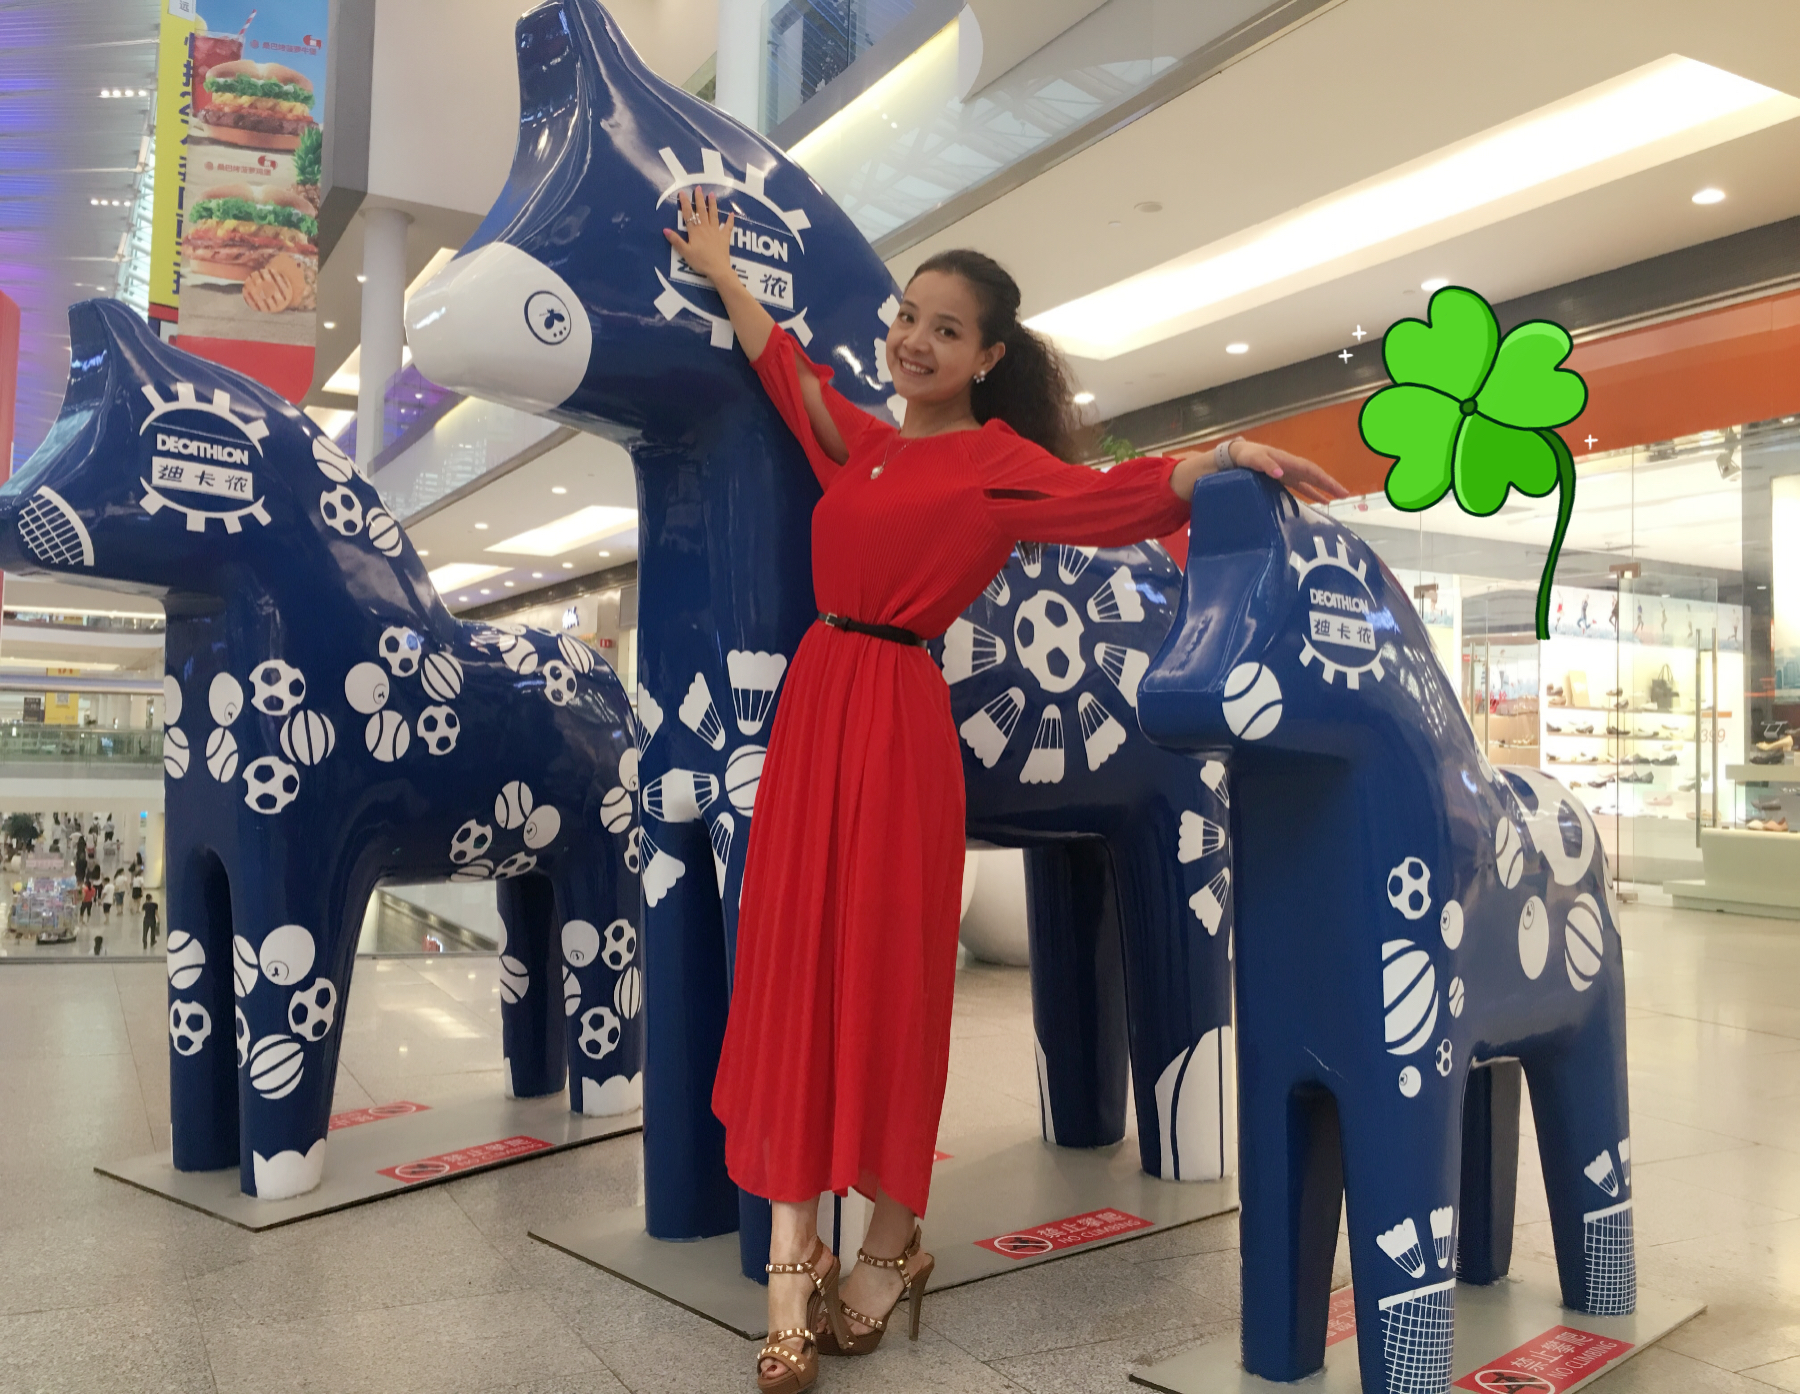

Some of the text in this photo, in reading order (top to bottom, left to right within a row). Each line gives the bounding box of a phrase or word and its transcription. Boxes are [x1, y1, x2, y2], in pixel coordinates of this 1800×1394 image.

[677, 210, 788, 263] DTHLON
[156, 433, 249, 466] DECATHLON
[158, 464, 248, 493] 迪卡侬
[1309, 588, 1370, 616] DECATHLON
[1313, 618, 1372, 645] 迪卡侬
[1057, 1235, 1081, 1245] NO
[1510, 1331, 1594, 1373] 禁止攀爬
[1546, 1340, 1618, 1380] NO CLIMBING
